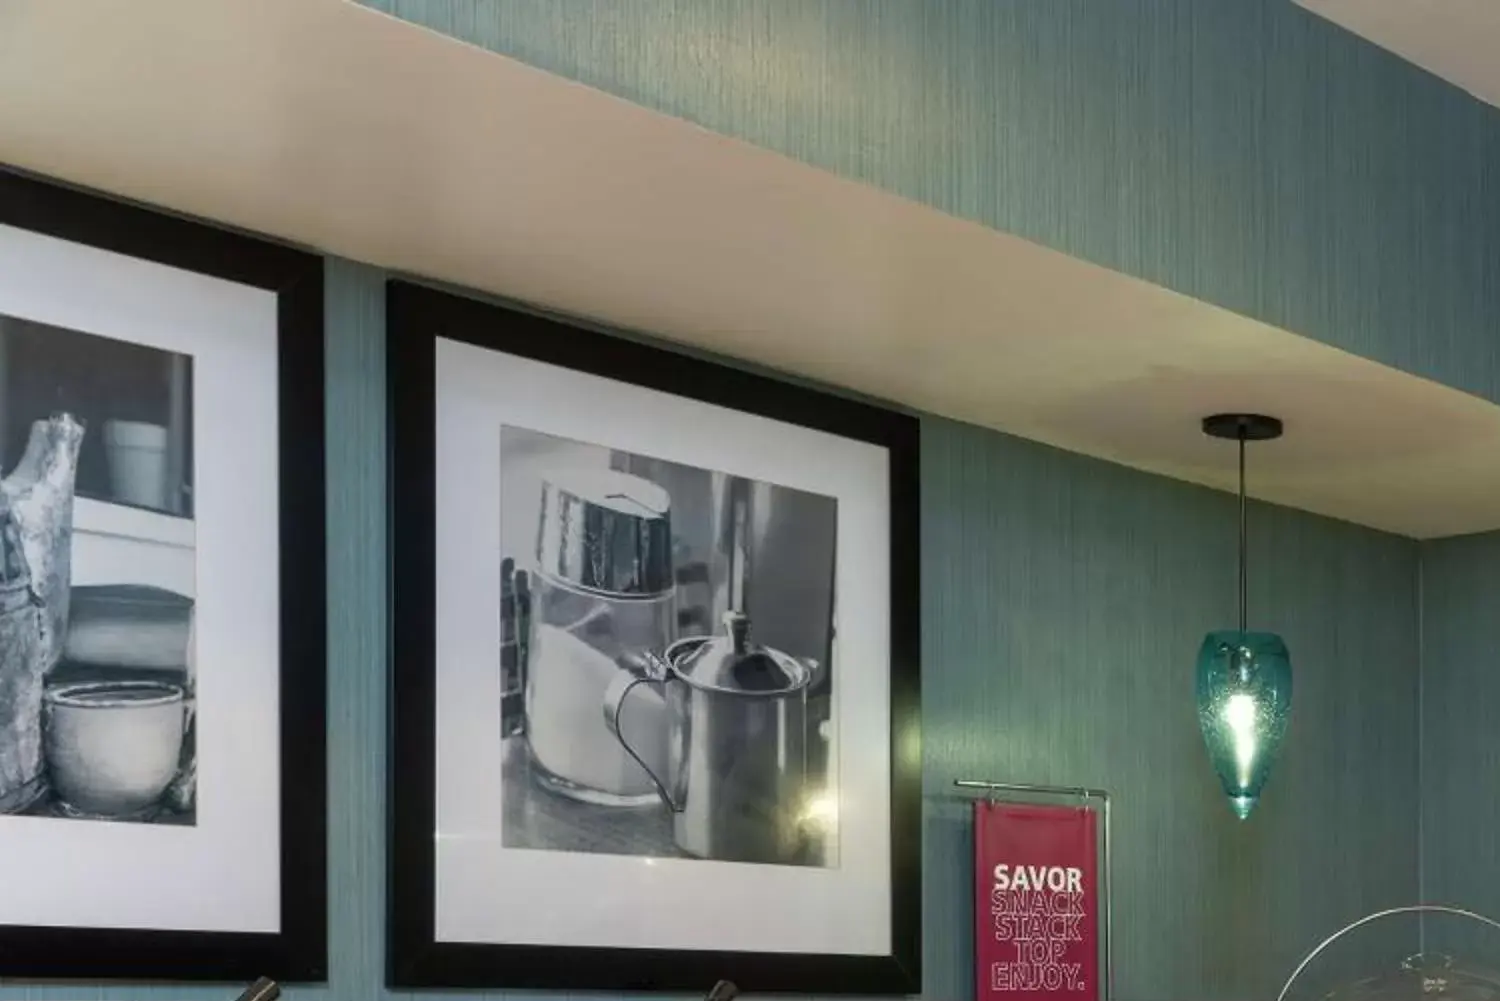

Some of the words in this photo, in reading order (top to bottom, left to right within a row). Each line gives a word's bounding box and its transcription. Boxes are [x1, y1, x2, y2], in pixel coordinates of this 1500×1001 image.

[993, 863, 1084, 893] SAVOR
[991, 889, 1086, 916] SNACK
[995, 913, 1083, 942] STACK
[1013, 938, 1066, 966] TOP
[991, 962, 1086, 991] ENJOY.
